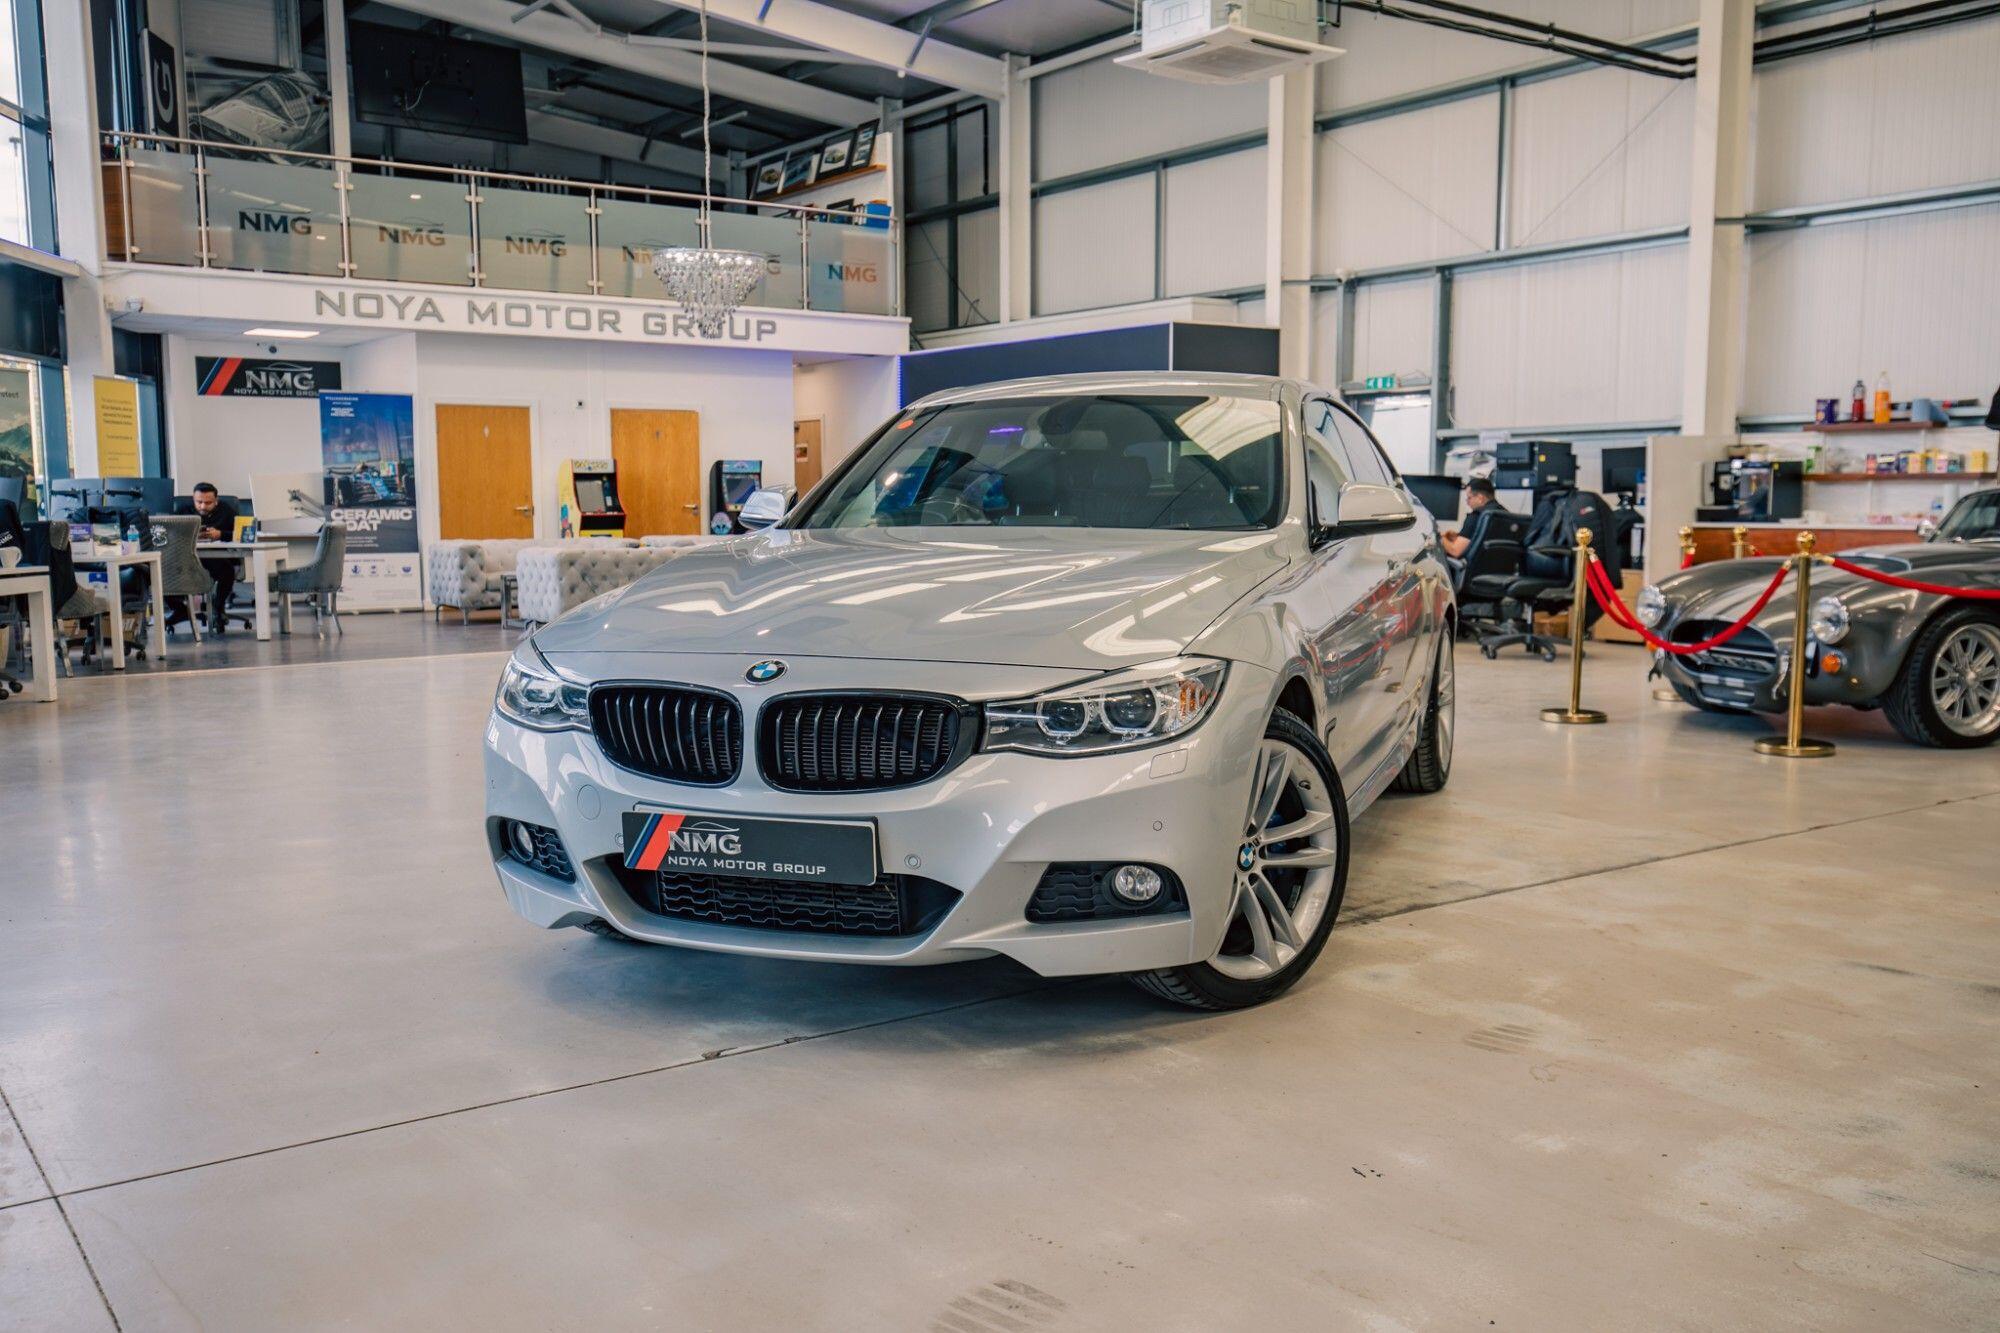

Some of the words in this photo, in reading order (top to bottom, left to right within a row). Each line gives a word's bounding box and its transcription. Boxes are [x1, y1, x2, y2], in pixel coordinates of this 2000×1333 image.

[239, 211, 312, 235] NMG
[379, 226, 446, 247] NMG
[505, 236, 567, 257] NMG
[828, 264, 877, 282] NMG
[315, 290, 445, 323] NOYA
[467, 300, 622, 333] MOTOR
[245, 370, 315, 390] NMG
[261, 388, 293, 396] MOTOR
[330, 508, 413, 521] CERAMIC
[667, 830, 742, 855] NMG
[668, 855, 708, 868] NOYA
[713, 858, 767, 872] MOTOR
[773, 863, 826, 875] GROUP
